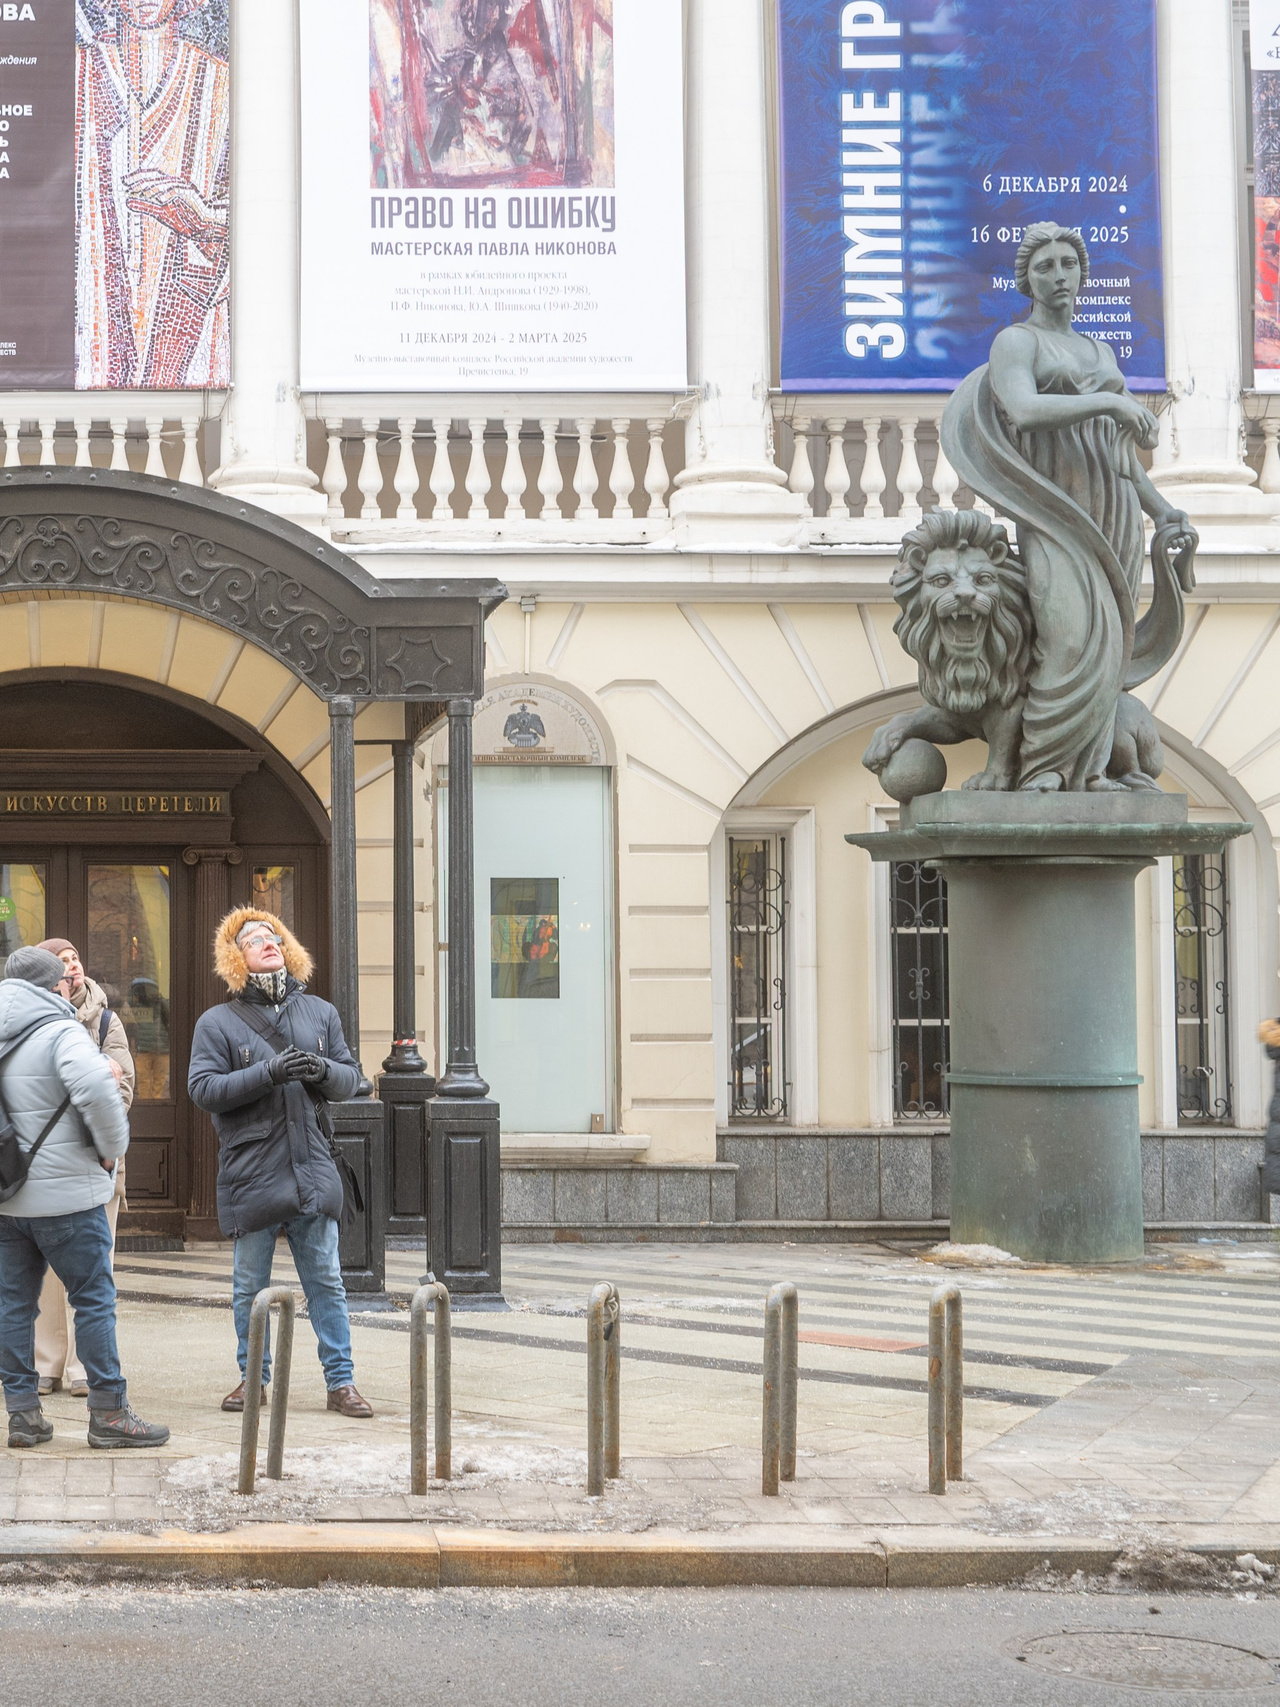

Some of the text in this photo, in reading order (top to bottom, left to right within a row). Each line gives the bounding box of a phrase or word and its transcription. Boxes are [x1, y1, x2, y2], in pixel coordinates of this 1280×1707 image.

[983, 174, 1128, 195] 6 ДЕКАБРЯ 2024
[843, 91, 906, 360] ЗИМНИЕ
[971, 225, 990, 243] 16
[1090, 226, 1129, 244] 2025
[370, 241, 617, 256] МАСТЕРСКАЯ ПАВЛА НИКОНОВА
[428, 272, 463, 282] рамках
[527, 271, 568, 282] проекта
[1075, 295, 1131, 306] комплекс
[400, 332, 410, 343] 11
[414, 332, 468, 345] ДЕКАБРЯ
[472, 332, 497, 344] 2024
[508, 332, 515, 344] 2
[518, 332, 559, 344] МАРТА
[562, 332, 588, 344] 2025
[1119, 346, 1133, 359] 19
[6, 795, 108, 812] ИСКУССТВ
[121, 795, 222, 815] ЦЕРЕТЕЛИ
